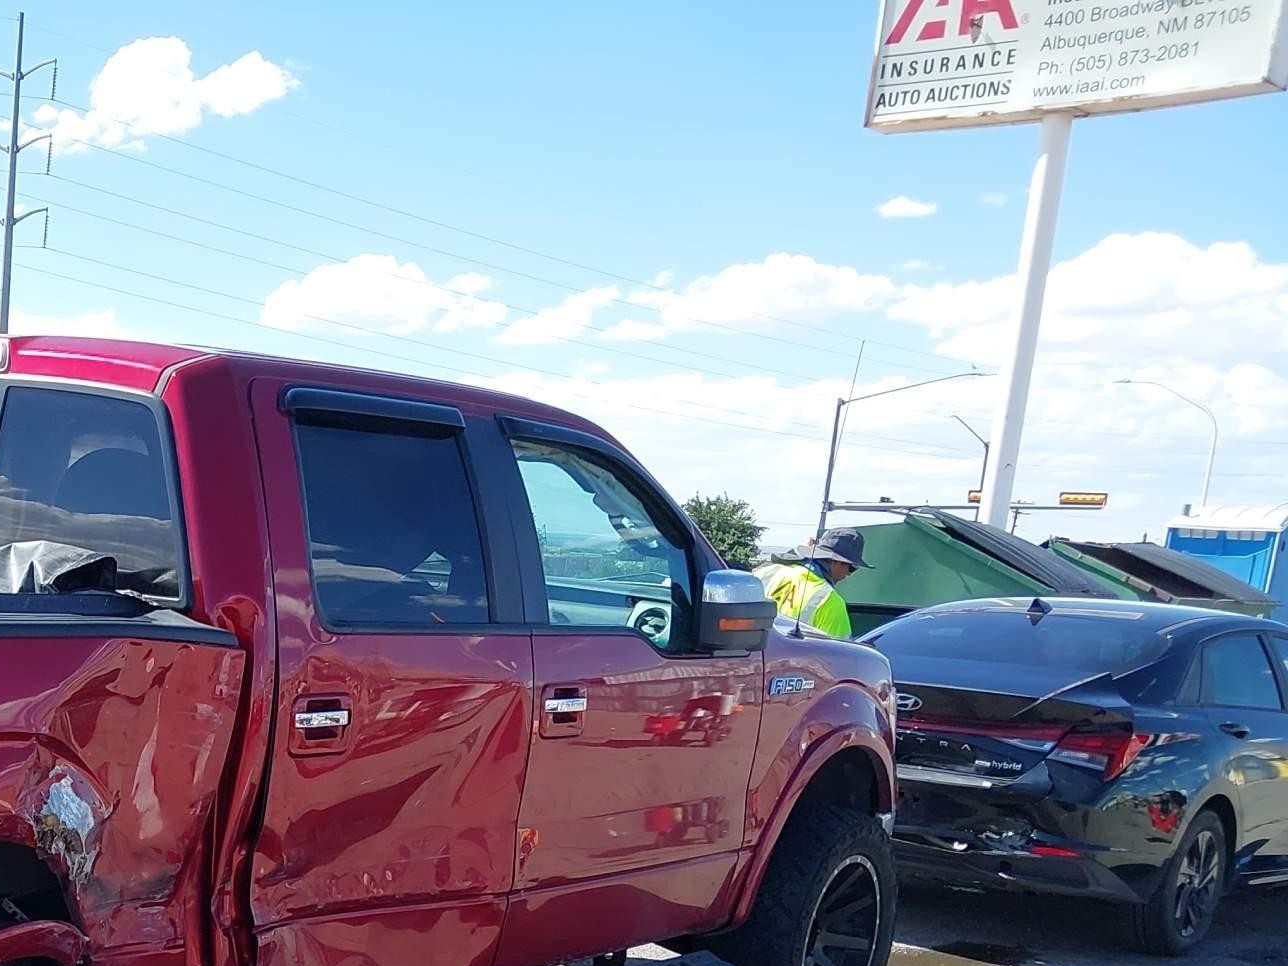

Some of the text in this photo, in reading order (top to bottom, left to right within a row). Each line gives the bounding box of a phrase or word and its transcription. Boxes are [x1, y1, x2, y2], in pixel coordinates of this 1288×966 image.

[1043, 9, 1085, 28] 4400
[1090, 0, 1173, 22] Broadway
[1157, 16, 1188, 35] NM
[1193, 5, 1251, 30] 87105
[880, 48, 1017, 80] INSURANCE
[1037, 41, 1199, 76] Ph: (505) 873-2081
[875, 80, 1012, 109] AUTO AUCTIONS
[1033, 74, 1146, 97] www.iaai.com
[896, 735, 971, 751] NTRA
[992, 760, 1022, 771] hybrid
